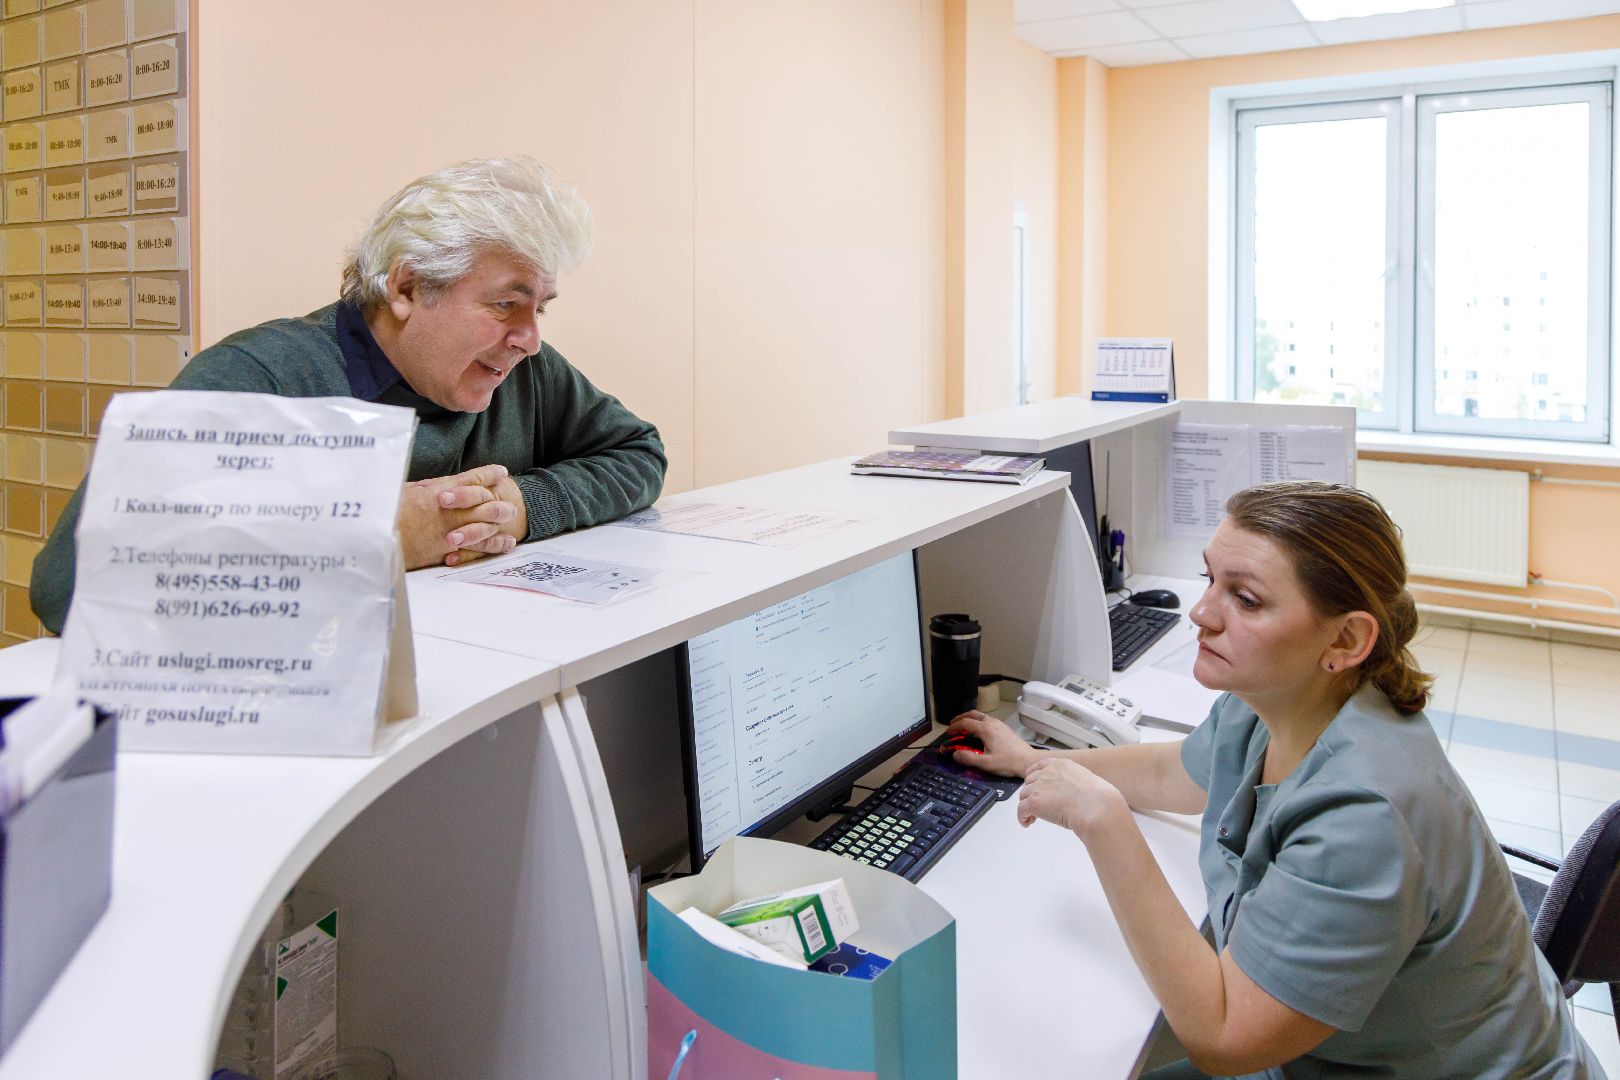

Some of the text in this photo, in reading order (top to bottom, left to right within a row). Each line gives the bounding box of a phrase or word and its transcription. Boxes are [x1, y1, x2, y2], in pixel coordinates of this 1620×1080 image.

[135, 60, 170, 76] 8:00-16:20
[90, 74, 123, 89] 8:00-16:20
[104, 135, 118, 144] ТМК
[136, 177, 176, 191] 08:00-16:20
[90, 240, 127, 250] 14:00-19:40
[137, 238, 173, 250] 8:00-13:40
[47, 299, 81, 309] 14:00-19:40
[137, 293, 177, 306] 14:00-19:40
[127, 423, 376, 450] Запись на прием доступна
[216, 454, 275, 470] через:
[229, 503, 253, 516] по
[256, 503, 324, 522] номеру
[331, 501, 362, 518] 122
[218, 552, 345, 572] регистратуры
[155, 573, 301, 595] 8(495)558-43-00
[155, 599, 300, 619] 8(991)626-69-92
[157, 651, 313, 675] uslugi.mosreg.ru
[146, 705, 260, 727] gosuslugi.ru
